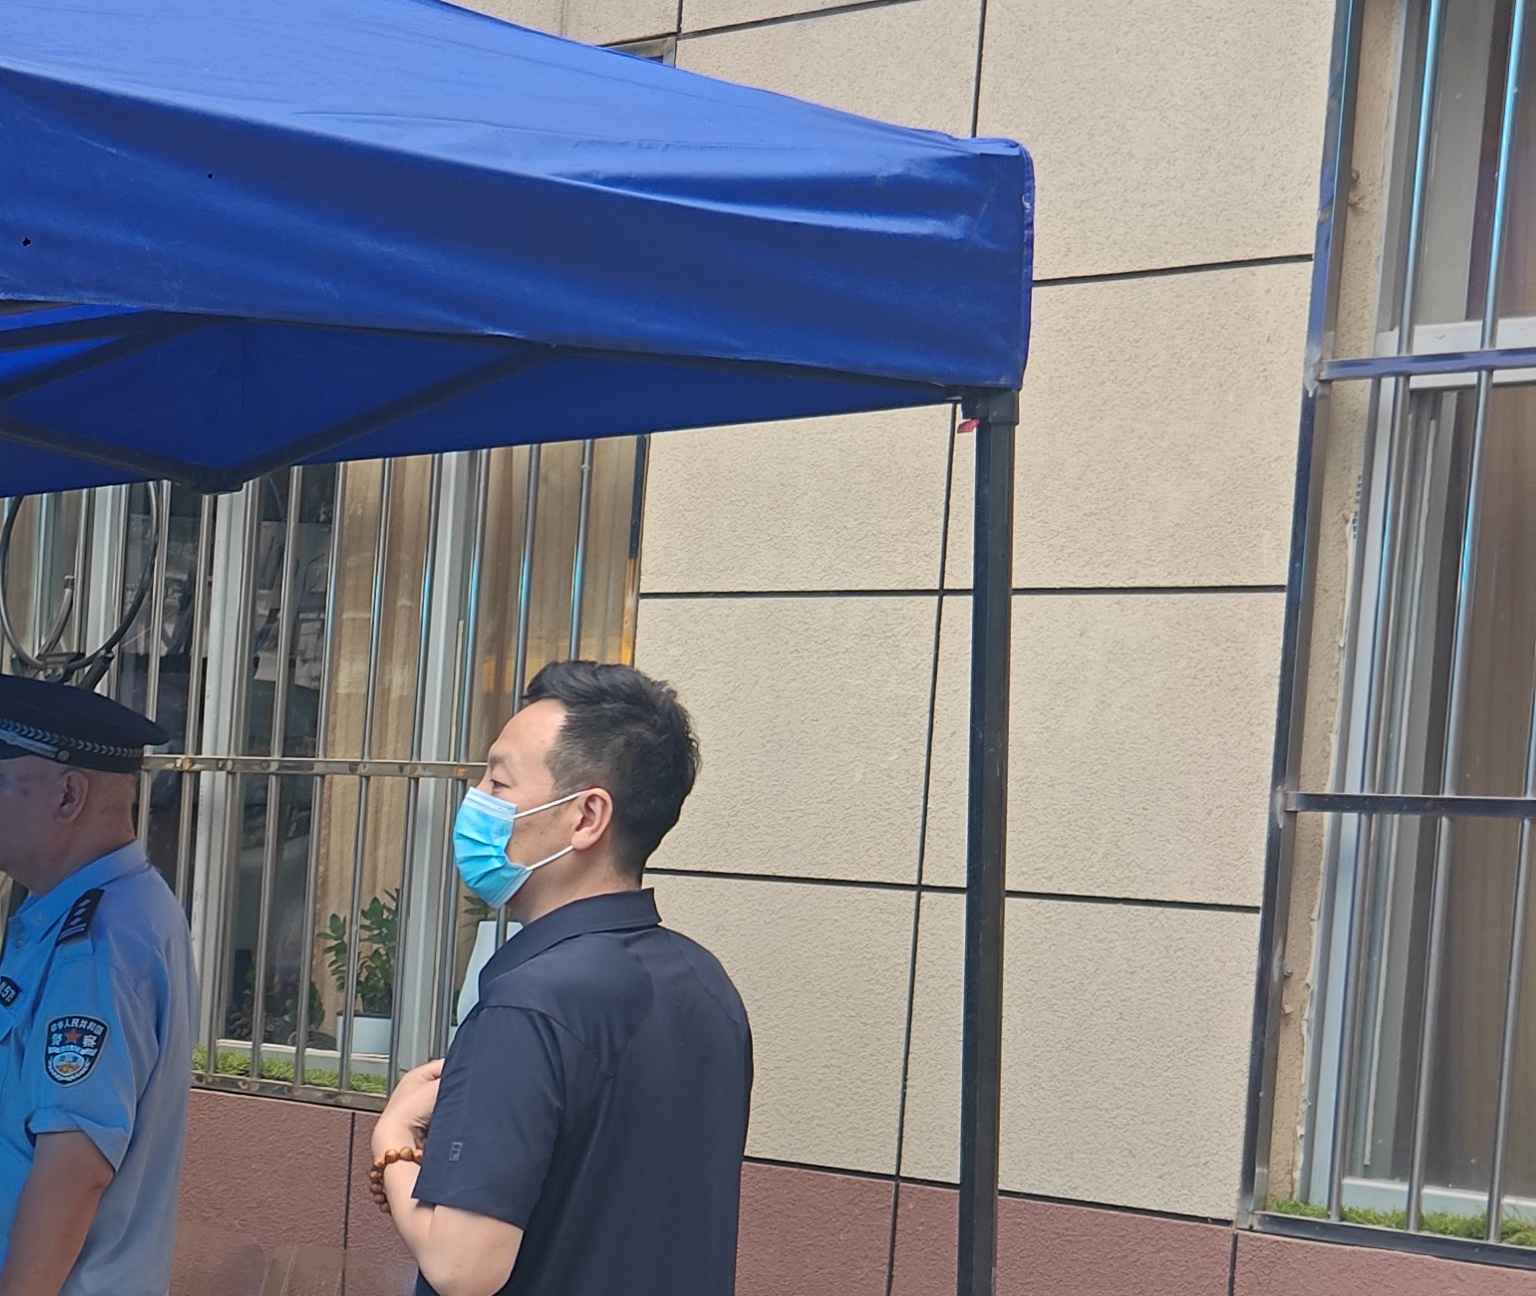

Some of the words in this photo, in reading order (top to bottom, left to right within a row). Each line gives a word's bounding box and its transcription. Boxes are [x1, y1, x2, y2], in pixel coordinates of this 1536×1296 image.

[50, 1018, 104, 1036] 中华人民共和国
